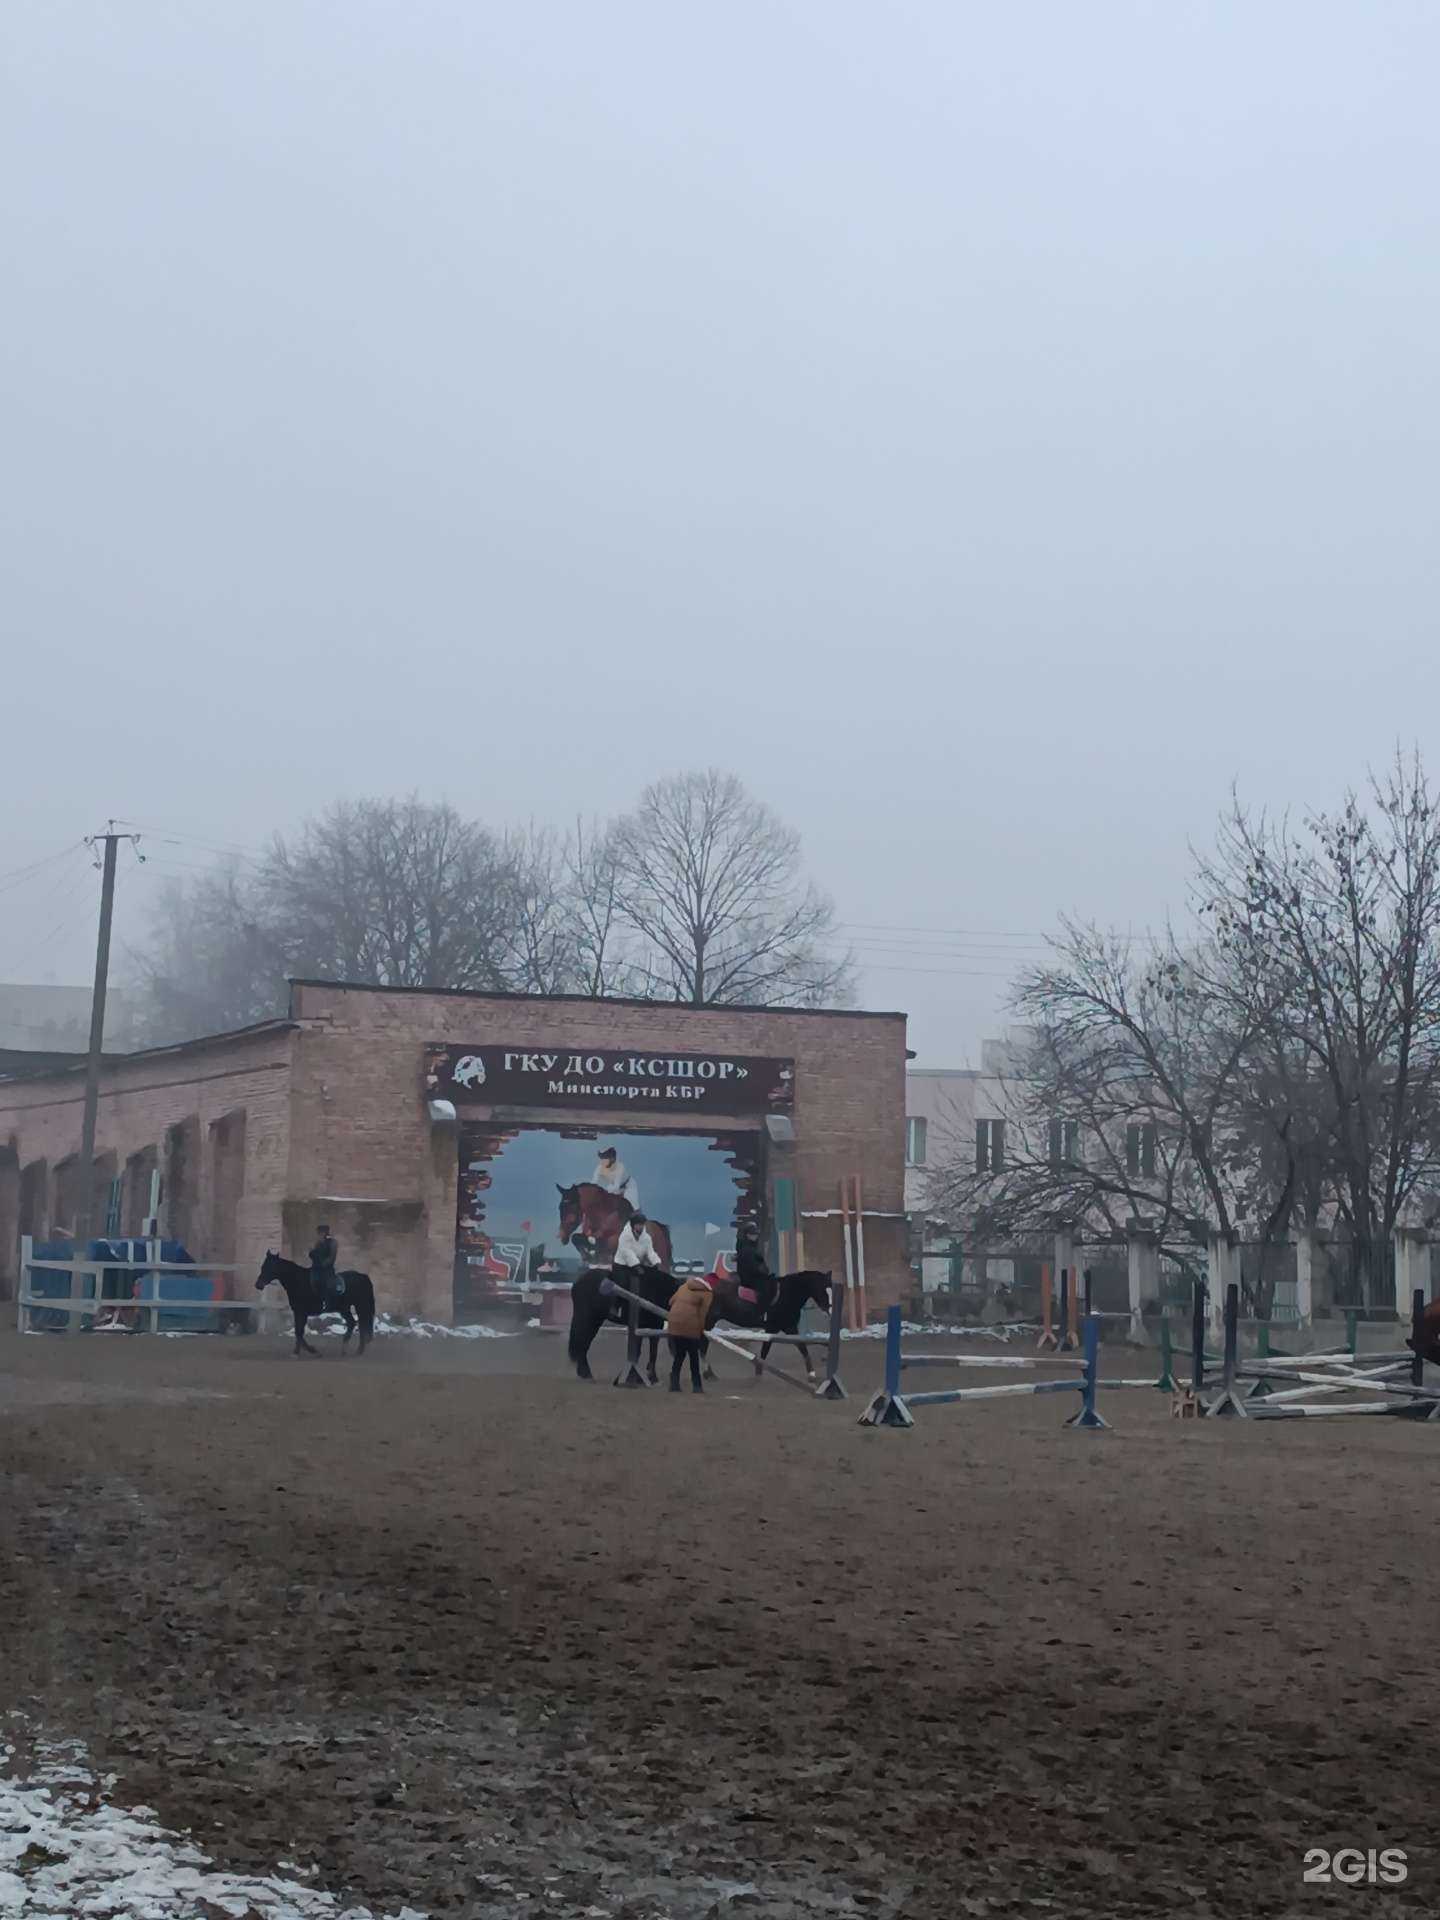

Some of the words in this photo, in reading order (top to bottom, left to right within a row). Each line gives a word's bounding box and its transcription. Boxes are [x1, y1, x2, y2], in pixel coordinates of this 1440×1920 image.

[504, 1053, 558, 1072] ГКУ
[563, 1054, 604, 1077] ДО
[613, 1057, 749, 1080] «КСШОР»
[665, 1084, 706, 1100] КБР
